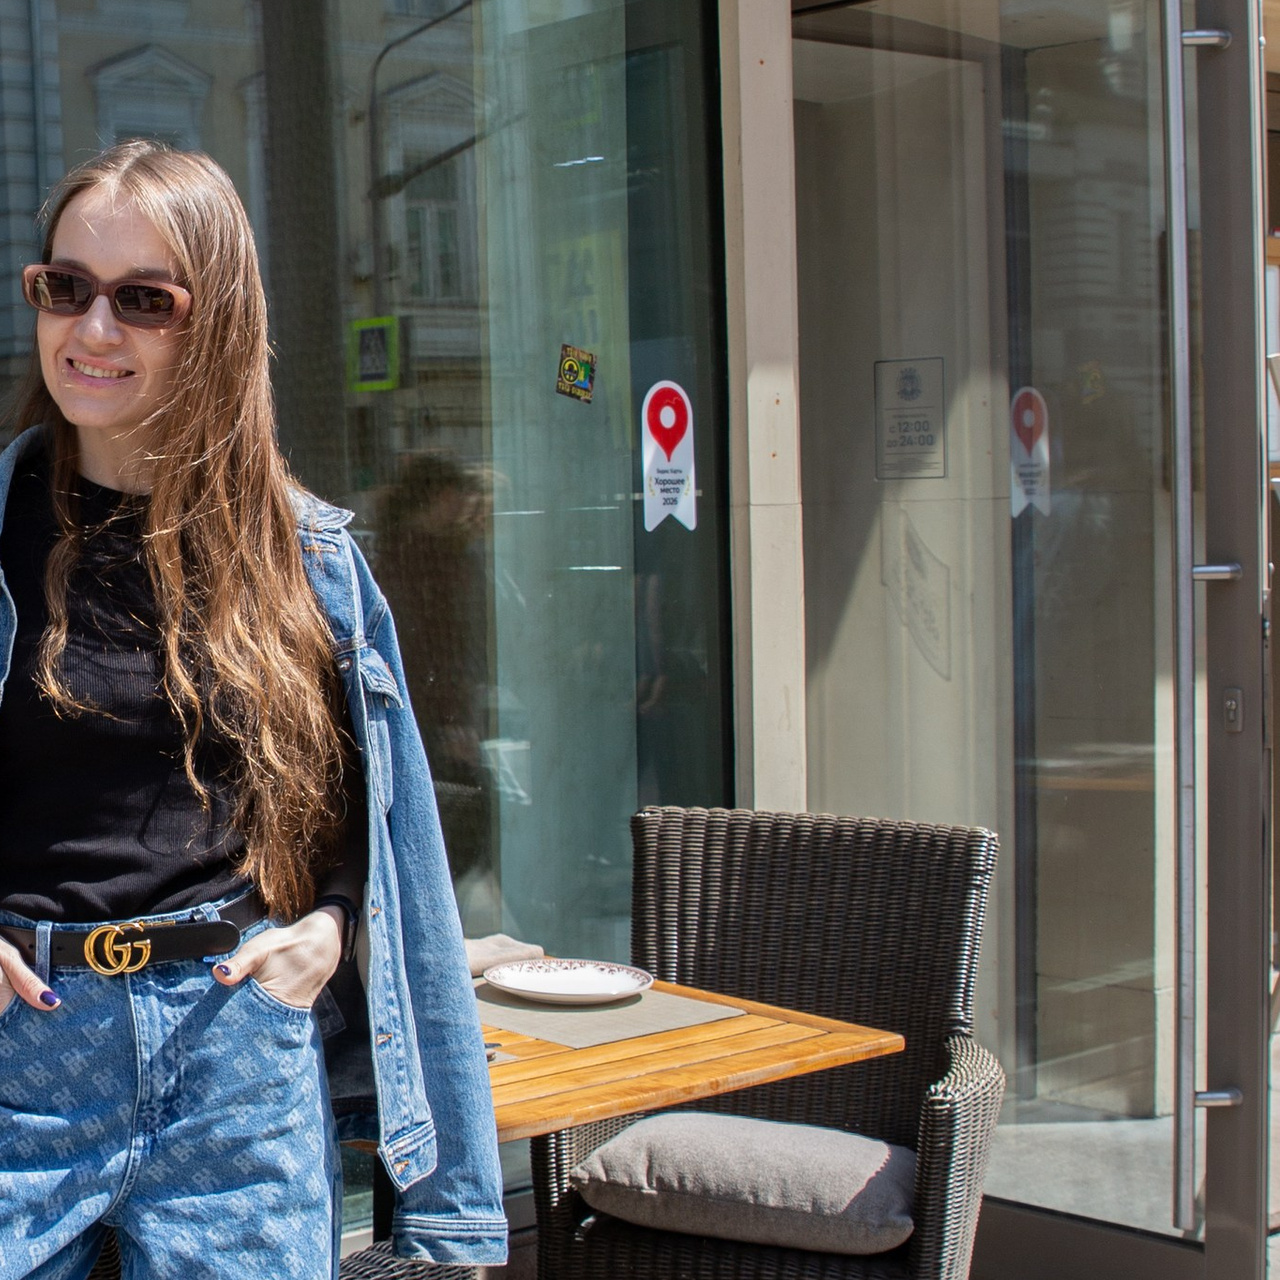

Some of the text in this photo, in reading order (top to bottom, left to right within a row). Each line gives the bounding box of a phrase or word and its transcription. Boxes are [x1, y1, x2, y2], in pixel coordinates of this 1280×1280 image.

[897, 420, 930, 433] 12:00
[899, 433, 934, 447] 24:00
[654, 476, 685, 487] Хорошее
